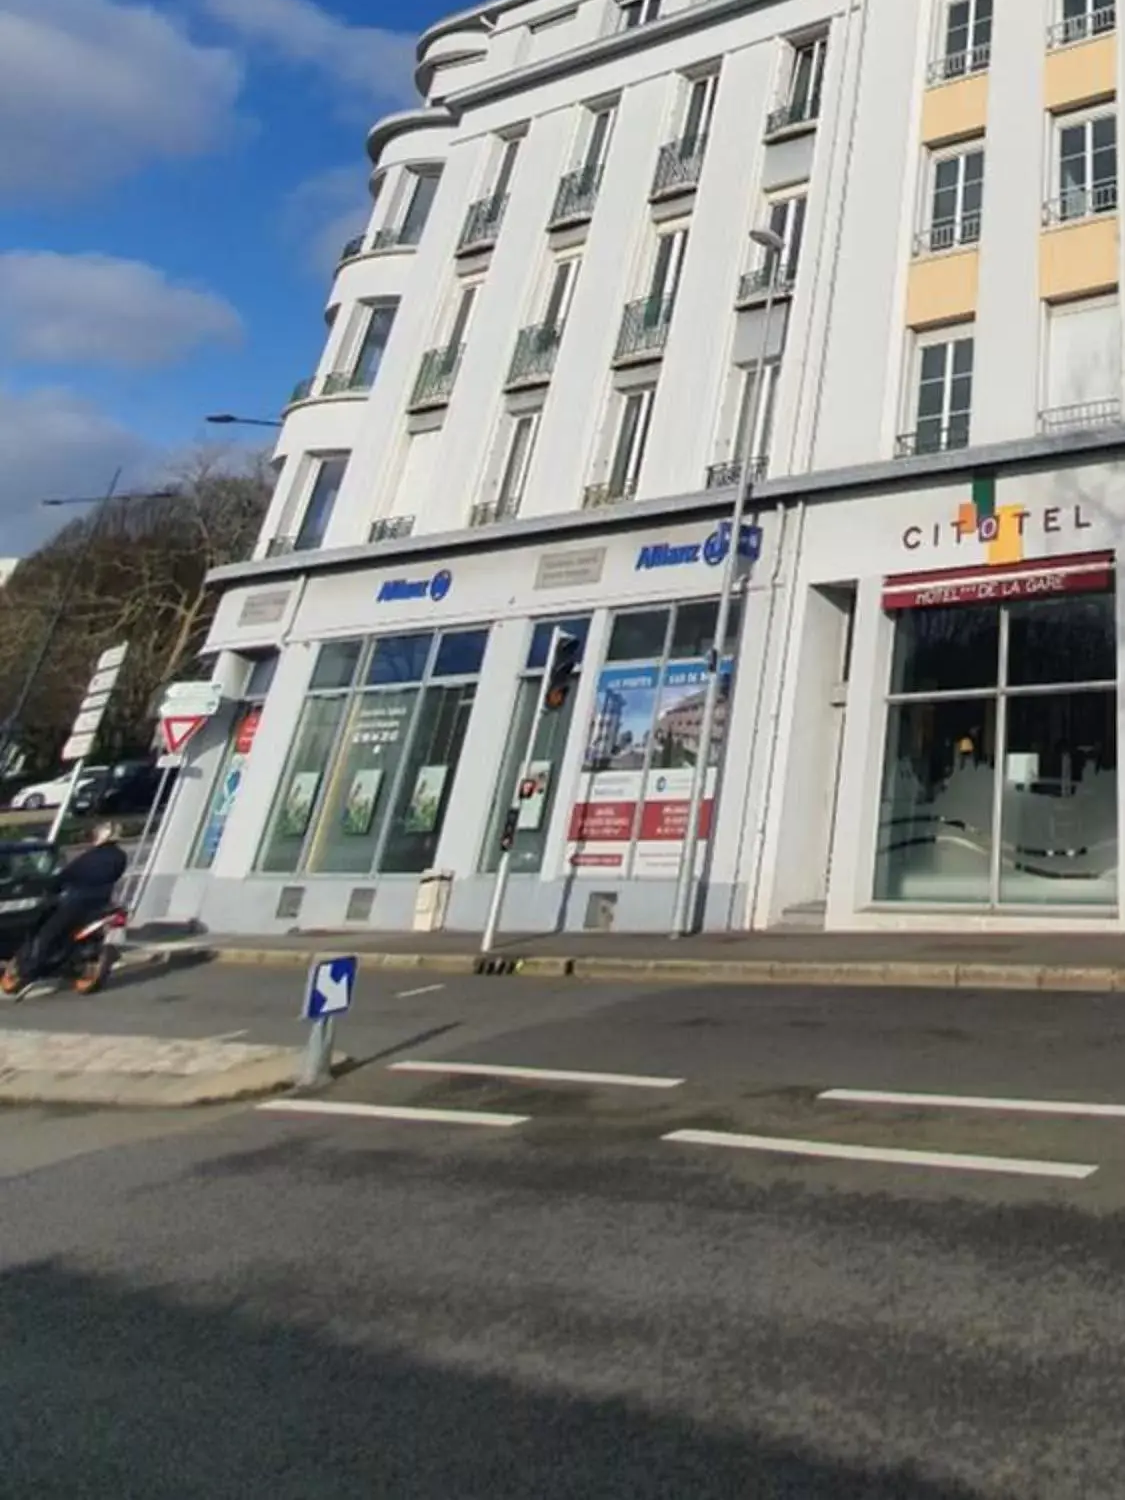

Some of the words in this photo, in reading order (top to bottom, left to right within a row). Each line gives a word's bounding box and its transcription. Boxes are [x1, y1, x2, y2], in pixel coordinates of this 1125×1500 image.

[902, 505, 1091, 549] CITOTEL
[636, 543, 700, 571] Allianz
[977, 580, 997, 598] DE
[1003, 581, 1020, 596] LA
[1026, 574, 1067, 593] GARE
